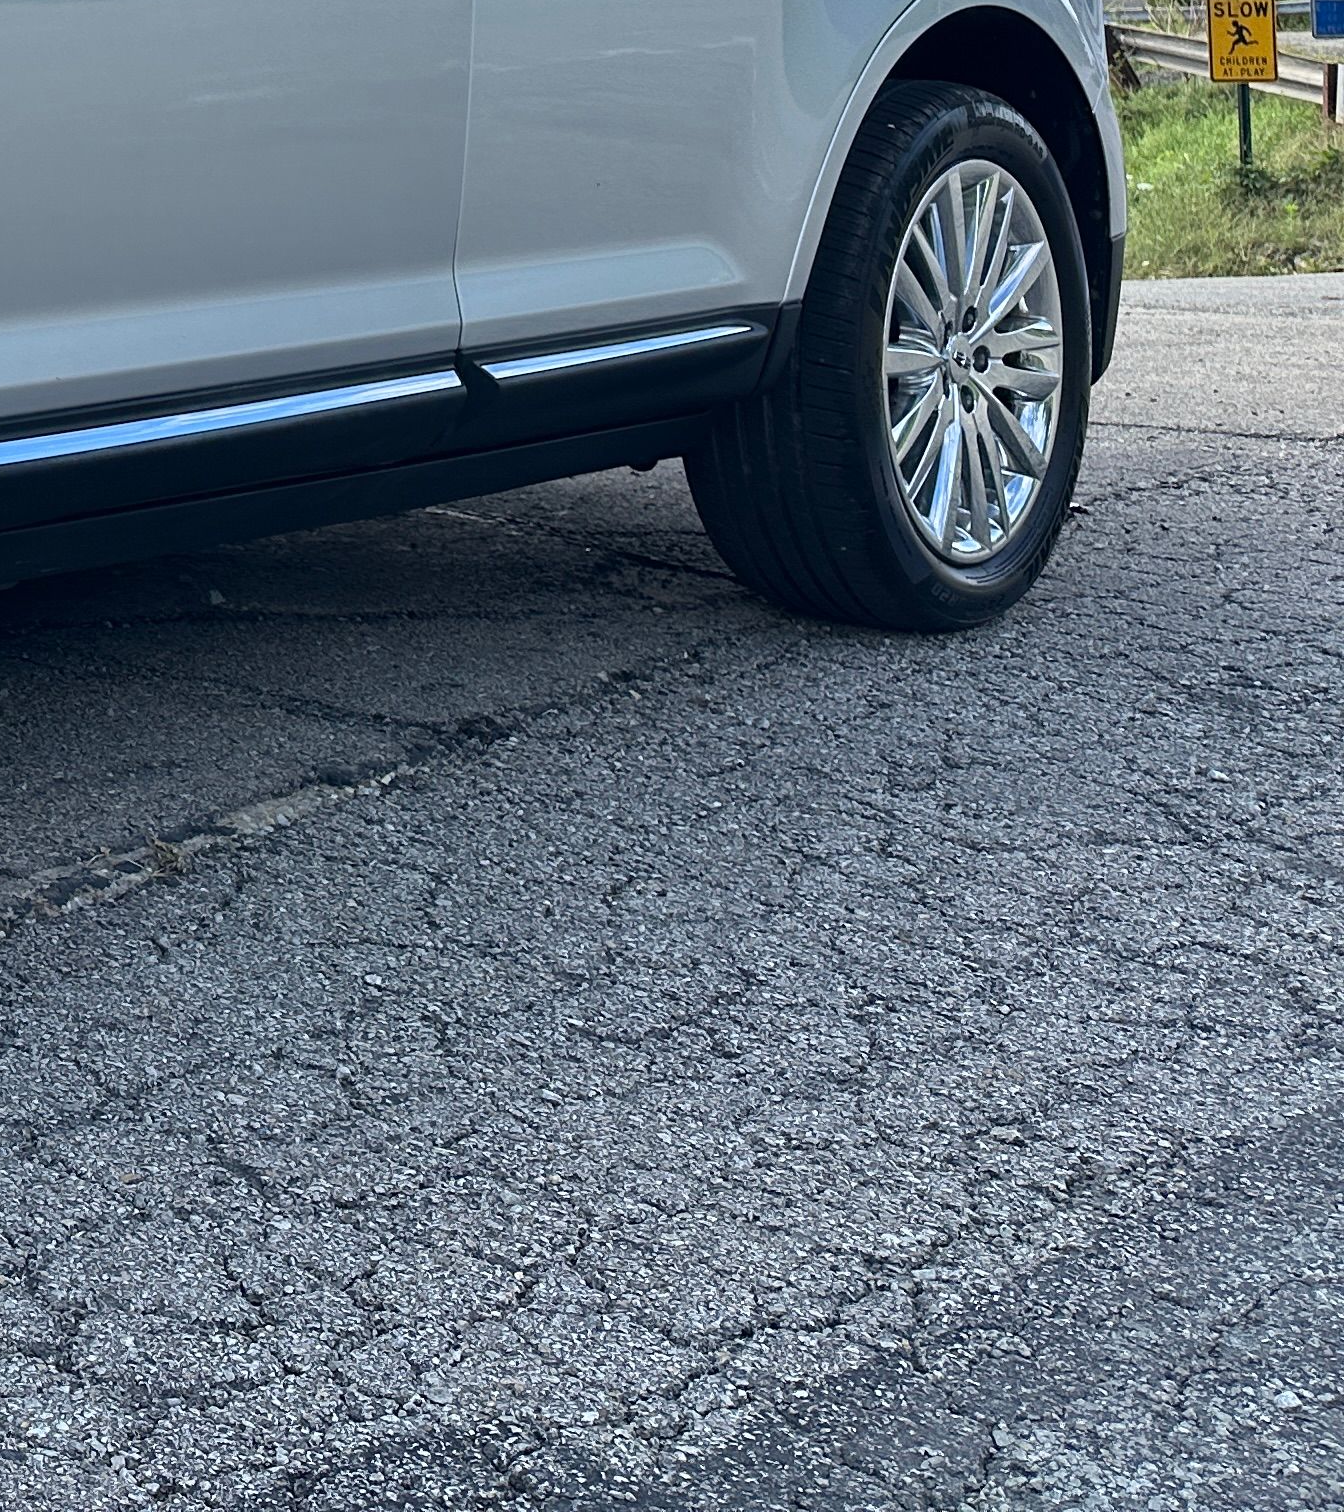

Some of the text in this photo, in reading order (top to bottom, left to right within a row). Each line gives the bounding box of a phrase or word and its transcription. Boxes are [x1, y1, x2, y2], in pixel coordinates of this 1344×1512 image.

[1213, 1, 1269, 18] SLOW
[1219, 55, 1268, 67] CHILDREN
[1223, 67, 1265, 77] AT PLAY
